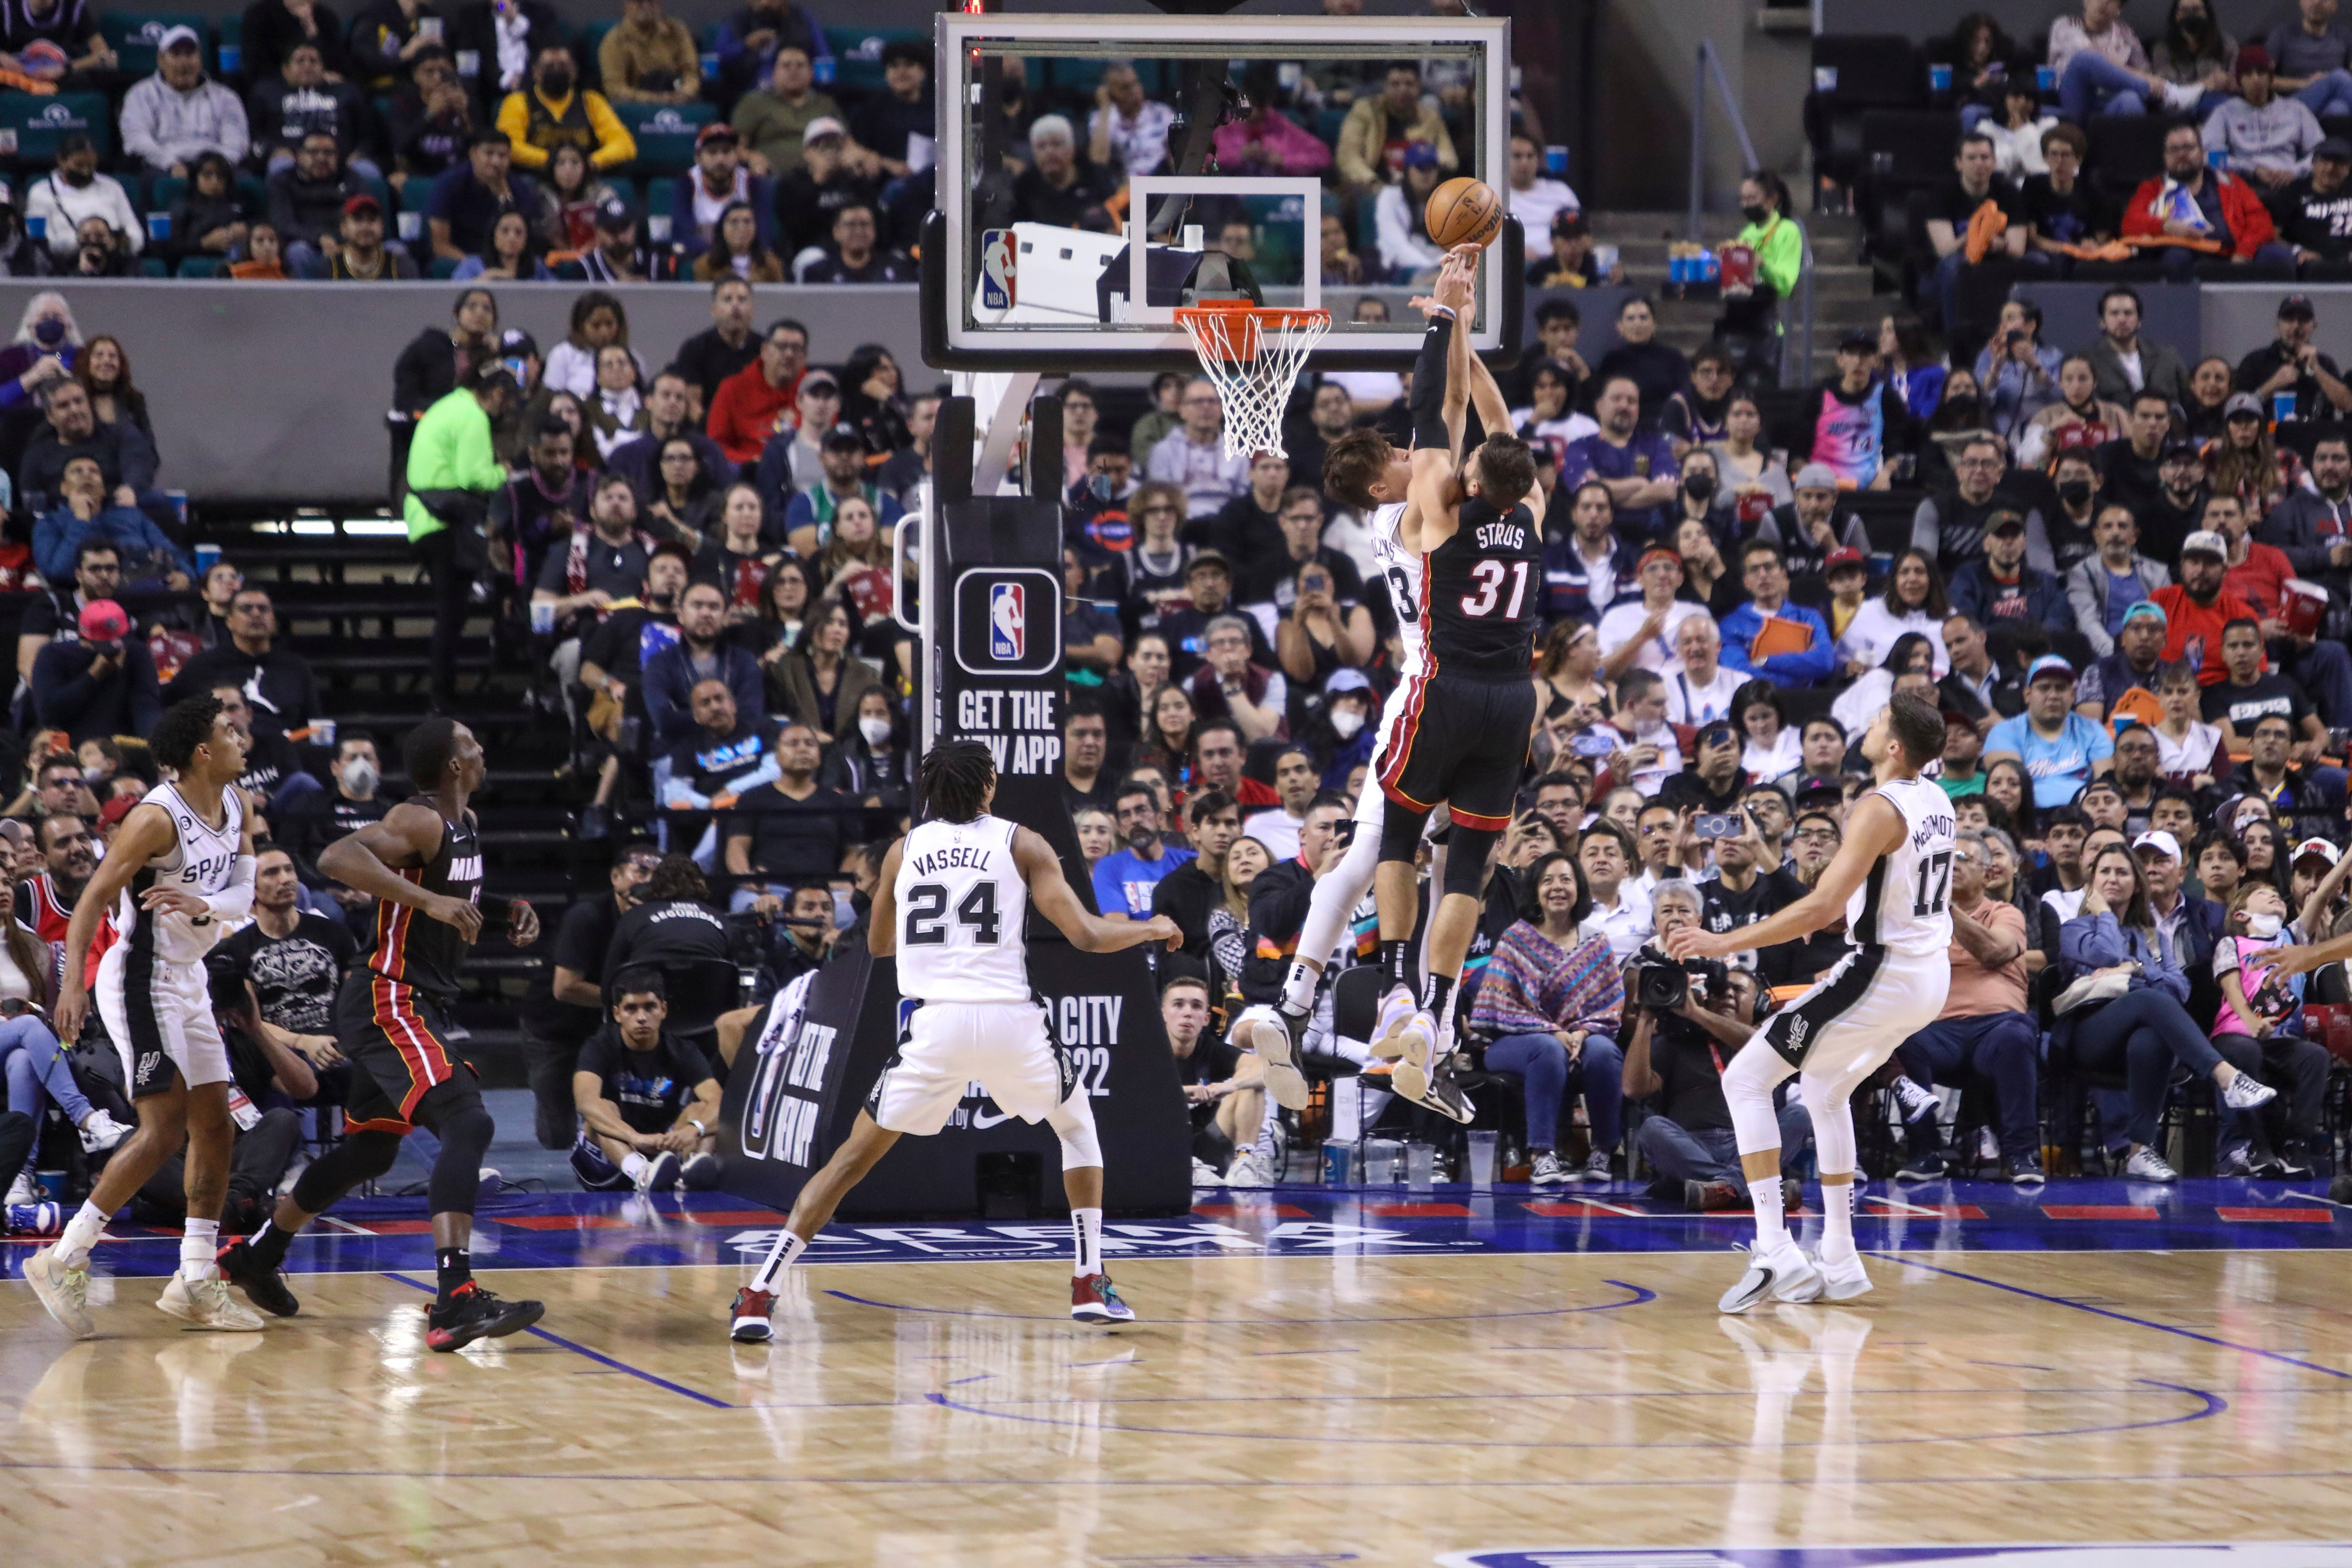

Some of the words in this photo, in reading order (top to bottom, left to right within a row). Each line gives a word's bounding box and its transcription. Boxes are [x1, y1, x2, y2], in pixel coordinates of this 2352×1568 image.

[987, 292, 1003, 306] NBA
[1476, 523, 1525, 550] STRUS
[1384, 564, 1420, 625] 3
[1460, 558, 1530, 621] 31
[995, 642, 1011, 655] NBA
[958, 690, 1004, 730] GET
[1009, 691, 1055, 730] THE
[1013, 736, 1060, 774] APP
[180, 816, 191, 830] 6
[913, 848, 991, 876] VASSELL
[1912, 849, 1955, 919] 17
[649, 908, 723, 930] SEGURIDAD
[904, 880, 1002, 948] 24
[1060, 996, 1123, 1046] CITY
[956, 1103, 969, 1130] by
[724, 1223, 1402, 1243] ARENA
